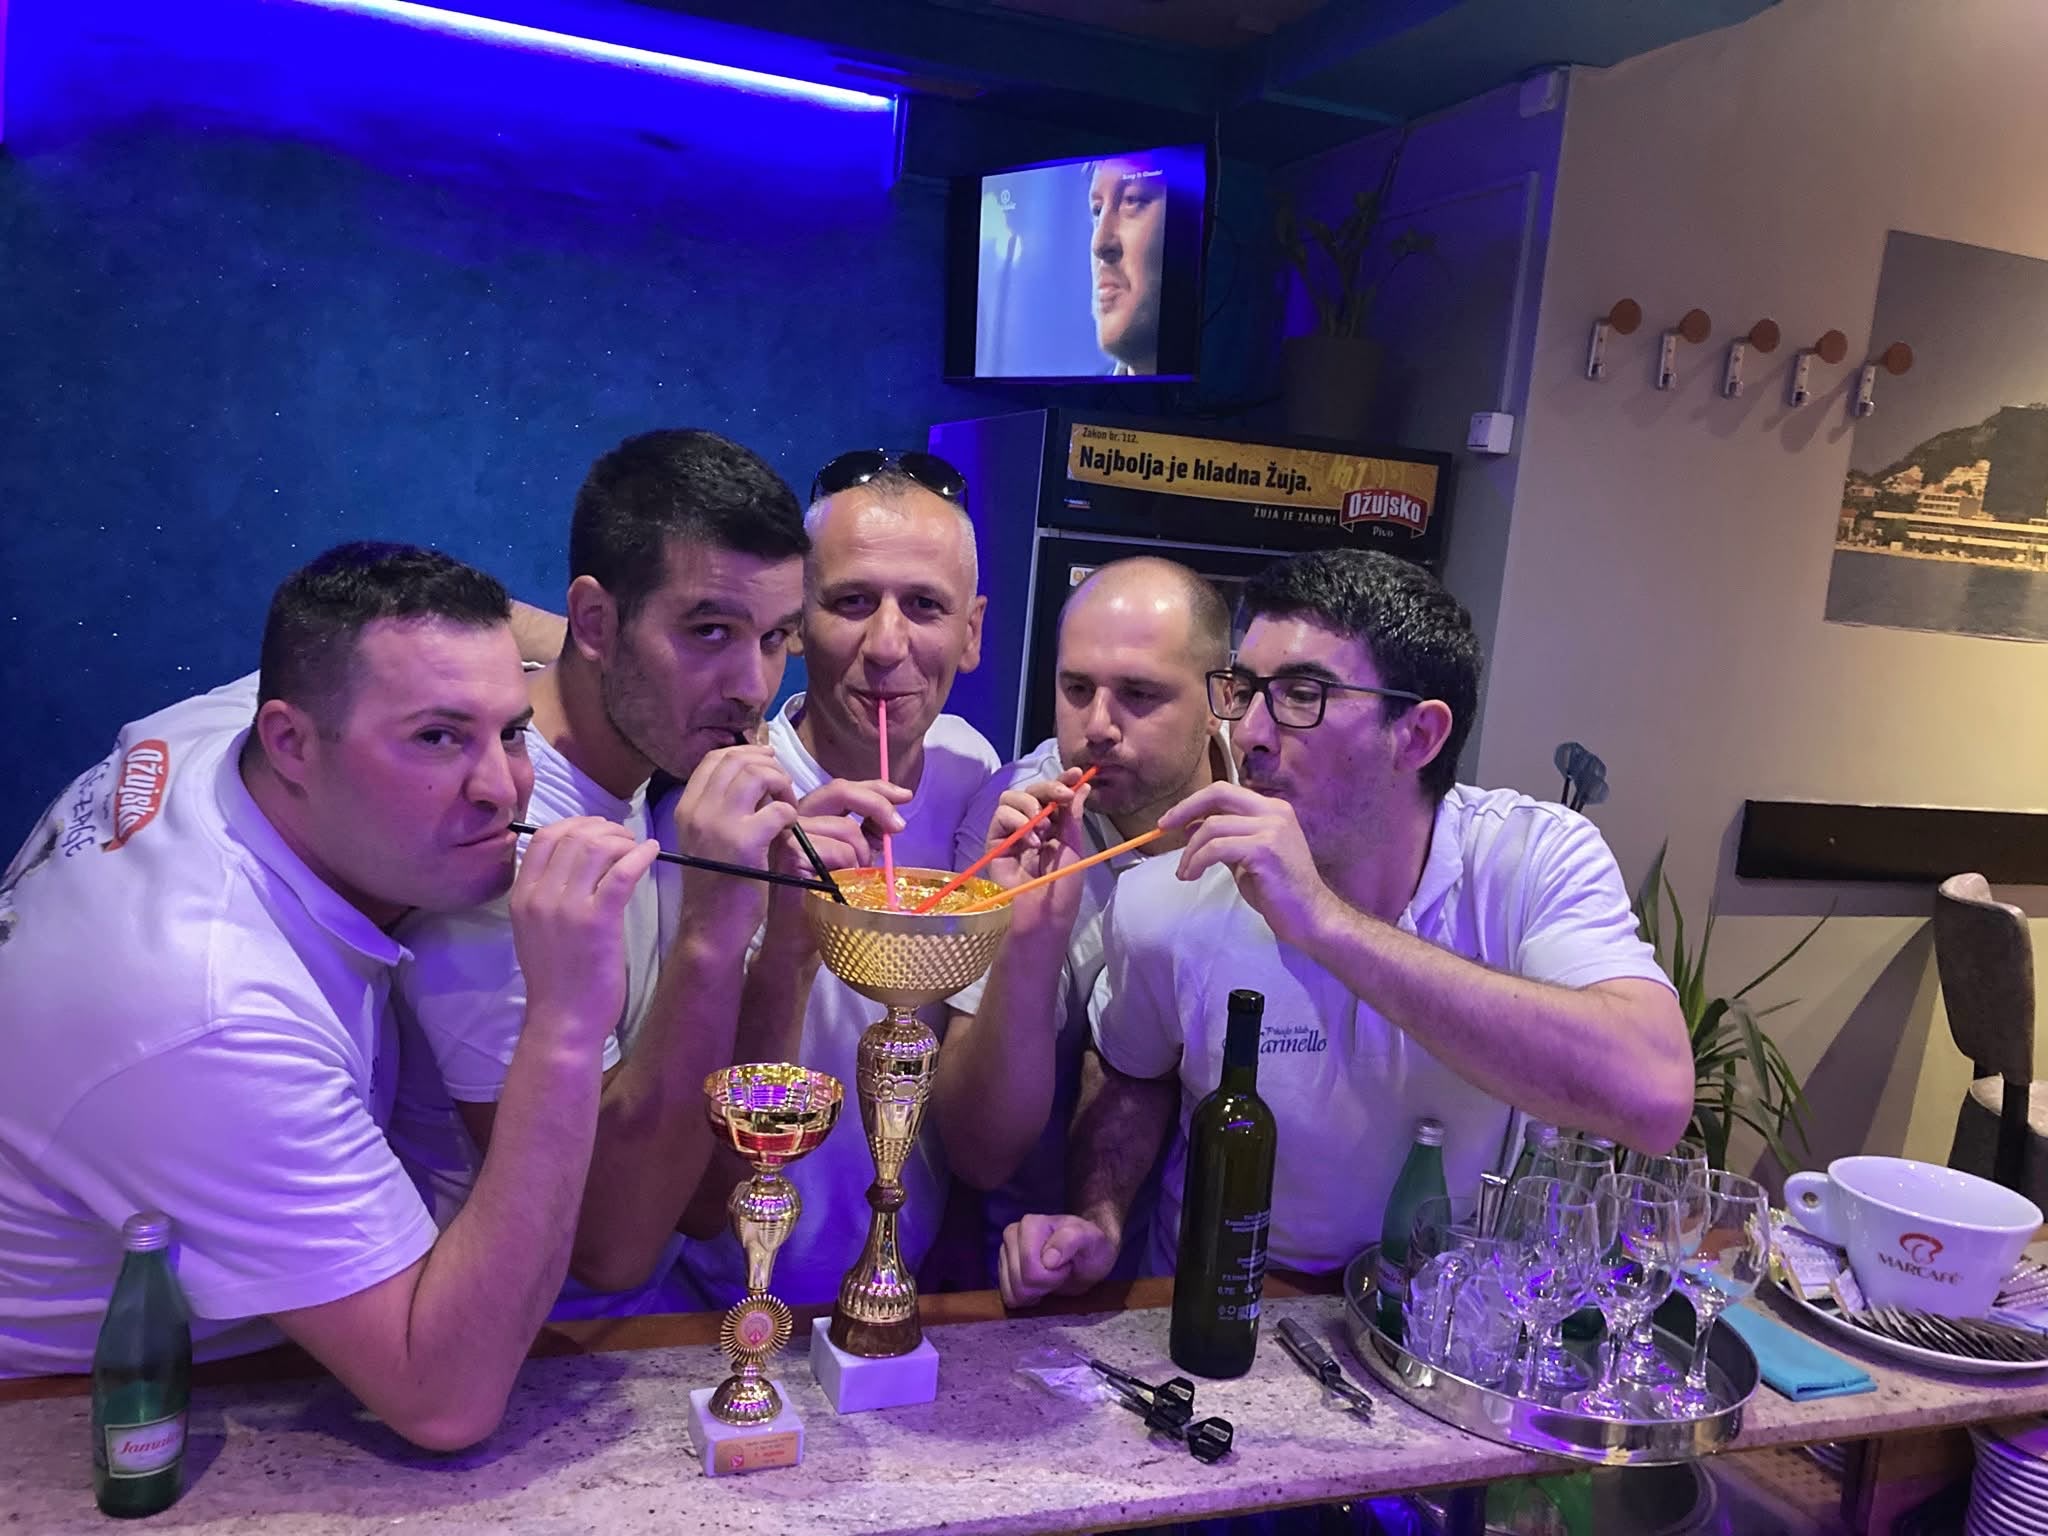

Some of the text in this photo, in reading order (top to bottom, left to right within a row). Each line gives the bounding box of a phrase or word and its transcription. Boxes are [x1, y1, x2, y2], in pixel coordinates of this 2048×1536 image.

[1083, 427, 1107, 440] Zakon
[1080, 445, 1312, 495] Najbolja je hladna Žuja.
[1254, 507, 1336, 525] ŽUJA JE ZAKON!
[1348, 491, 1421, 523] Ožujsko
[1260, 1029, 1327, 1055] arinello
